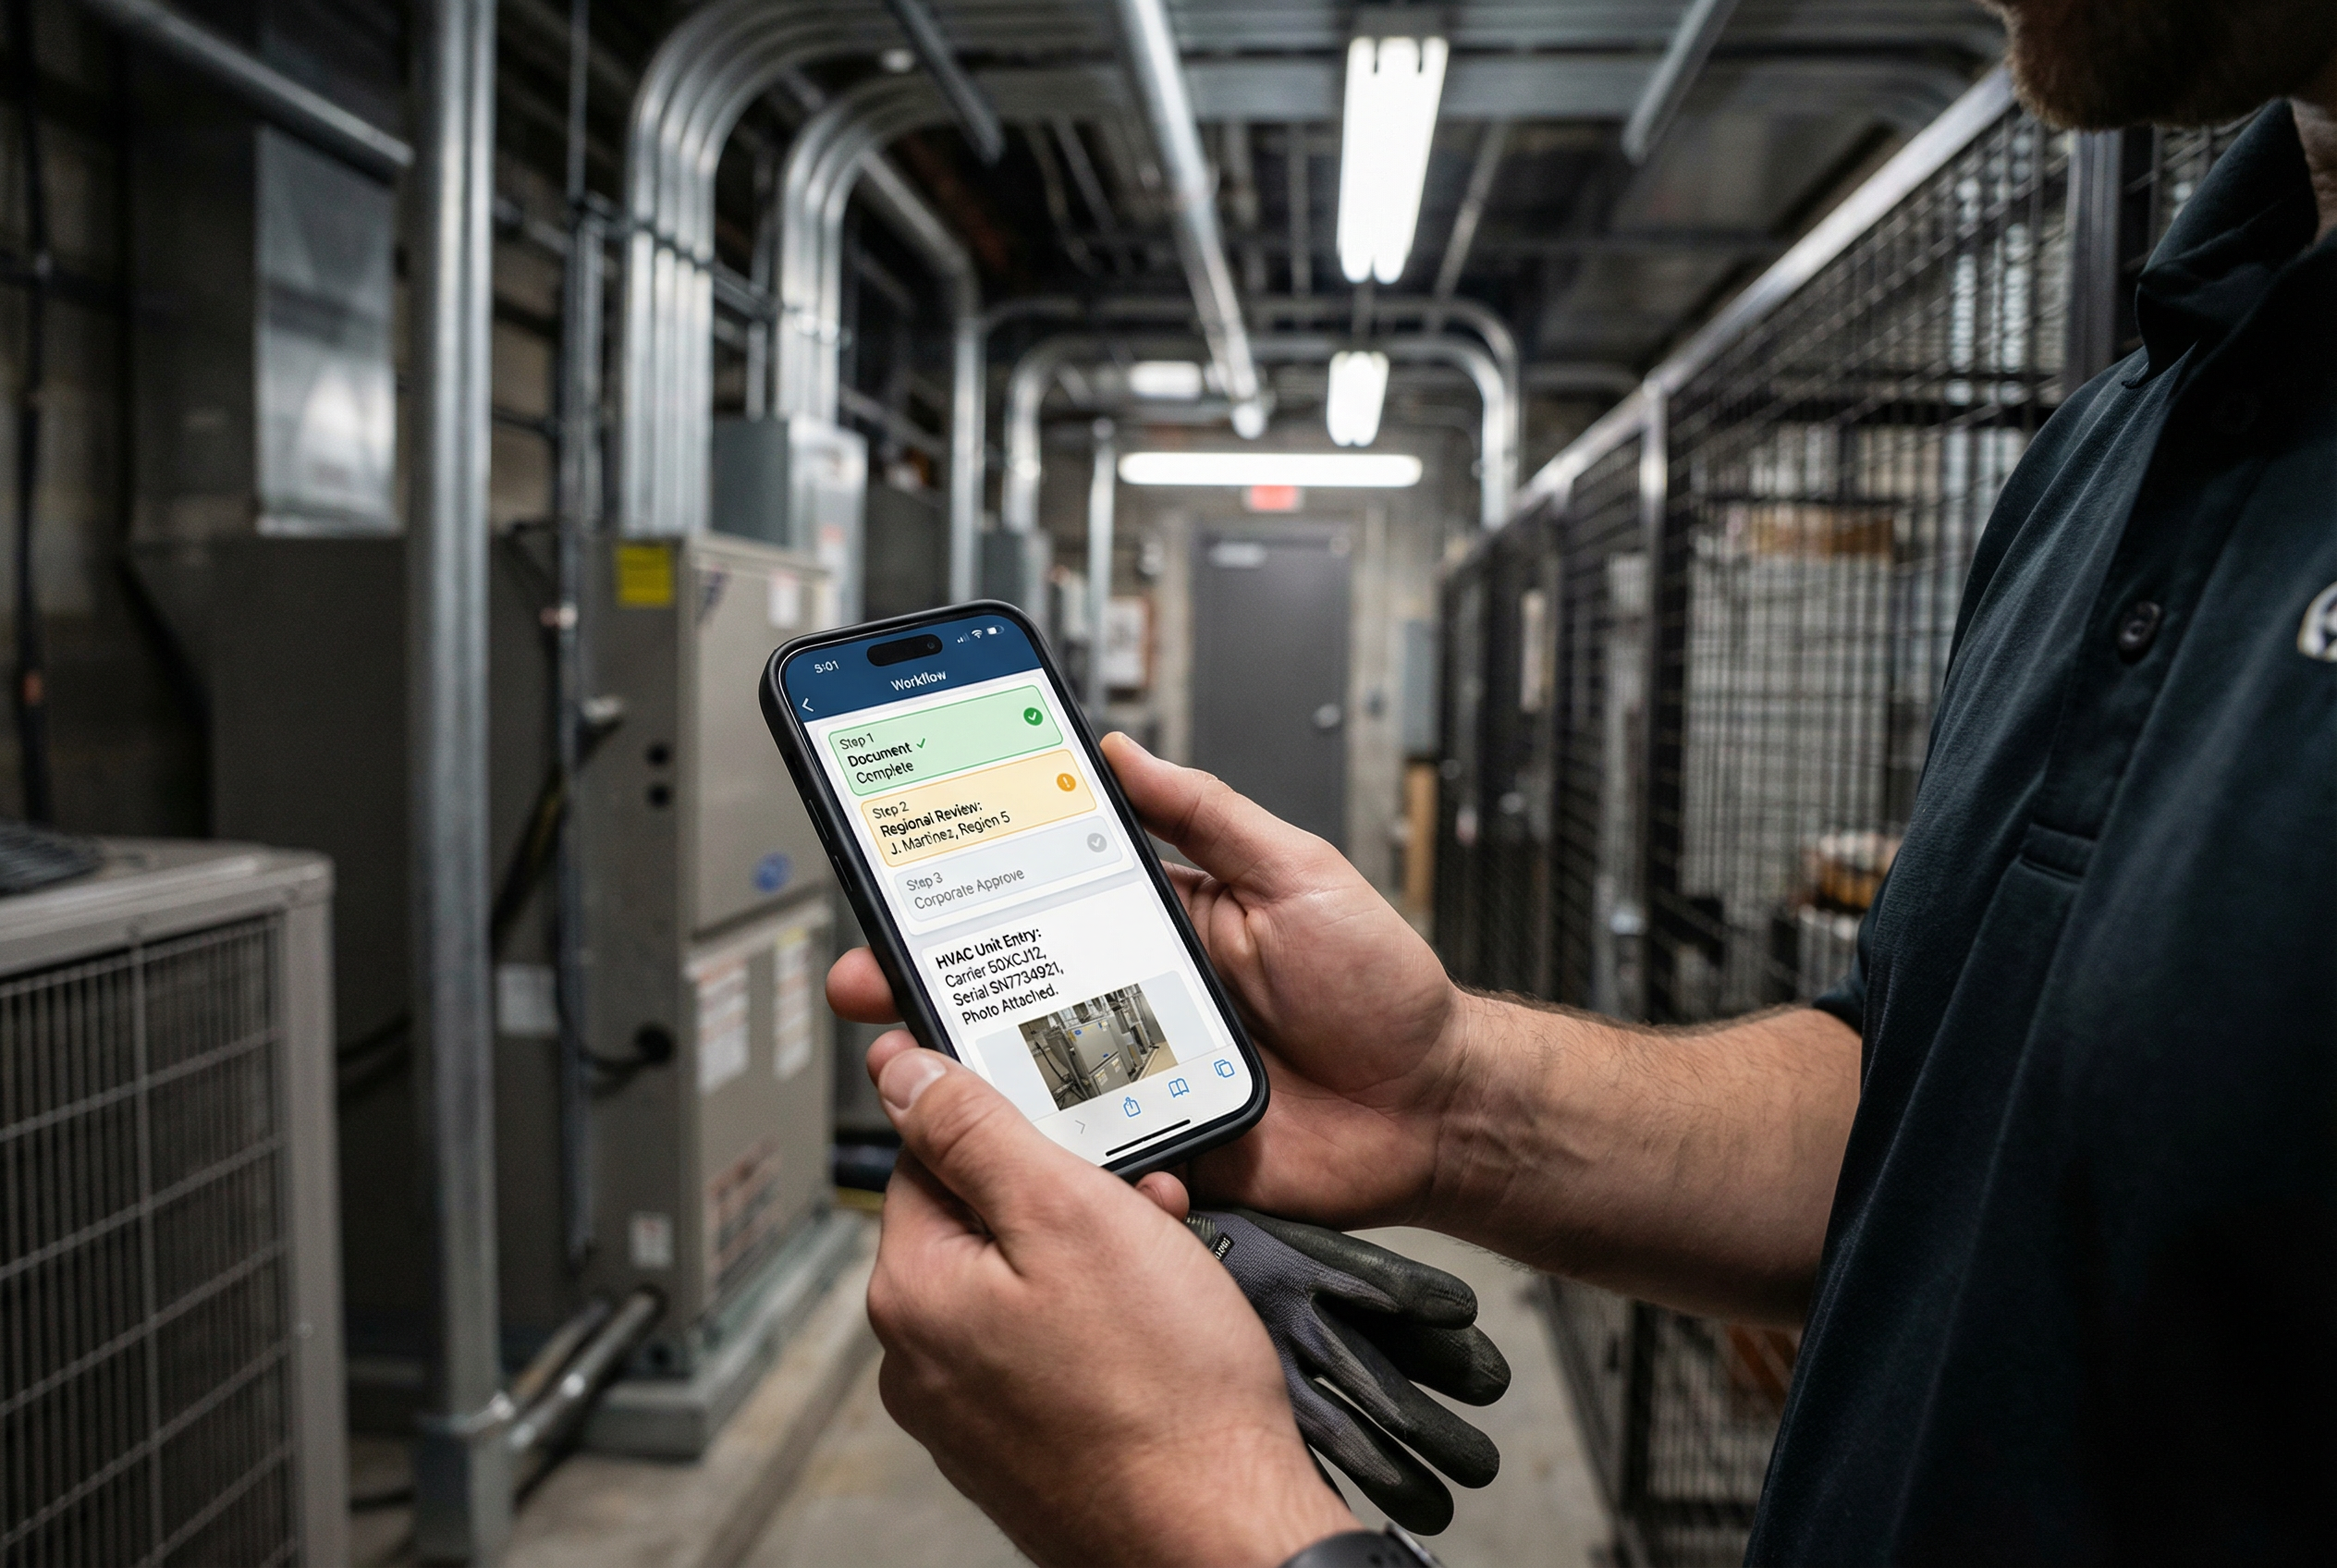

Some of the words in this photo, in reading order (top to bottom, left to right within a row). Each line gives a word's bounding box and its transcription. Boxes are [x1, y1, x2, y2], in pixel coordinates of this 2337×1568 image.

[890, 670, 947, 692] Workflow
[839, 737, 866, 750] Step
[866, 732, 875, 743] 1
[847, 741, 912, 767] Document
[856, 762, 914, 784] Complete
[872, 806, 899, 819] Step
[899, 801, 910, 813] 2
[880, 812, 935, 838] Regional
[935, 802, 983, 823] Review:
[890, 842, 902, 855] J.
[901, 828, 959, 851] Martinez,
[958, 816, 1000, 836] Region
[1000, 811, 1010, 824] 5
[906, 877, 934, 891] Step
[933, 872, 943, 884] 3
[914, 885, 974, 910] Corporate
[976, 869, 1025, 892] Approve
[936, 947, 974, 970] HVAC
[974, 937, 1003, 957] Unit
[1002, 928, 1042, 948] Entry:
[945, 966, 986, 987] Carrier
[952, 985, 990, 1007] Serial
[989, 961, 1064, 995] SN7734921,
[961, 1005, 999, 1025] Photo
[1001, 983, 1059, 1013] Attached.
